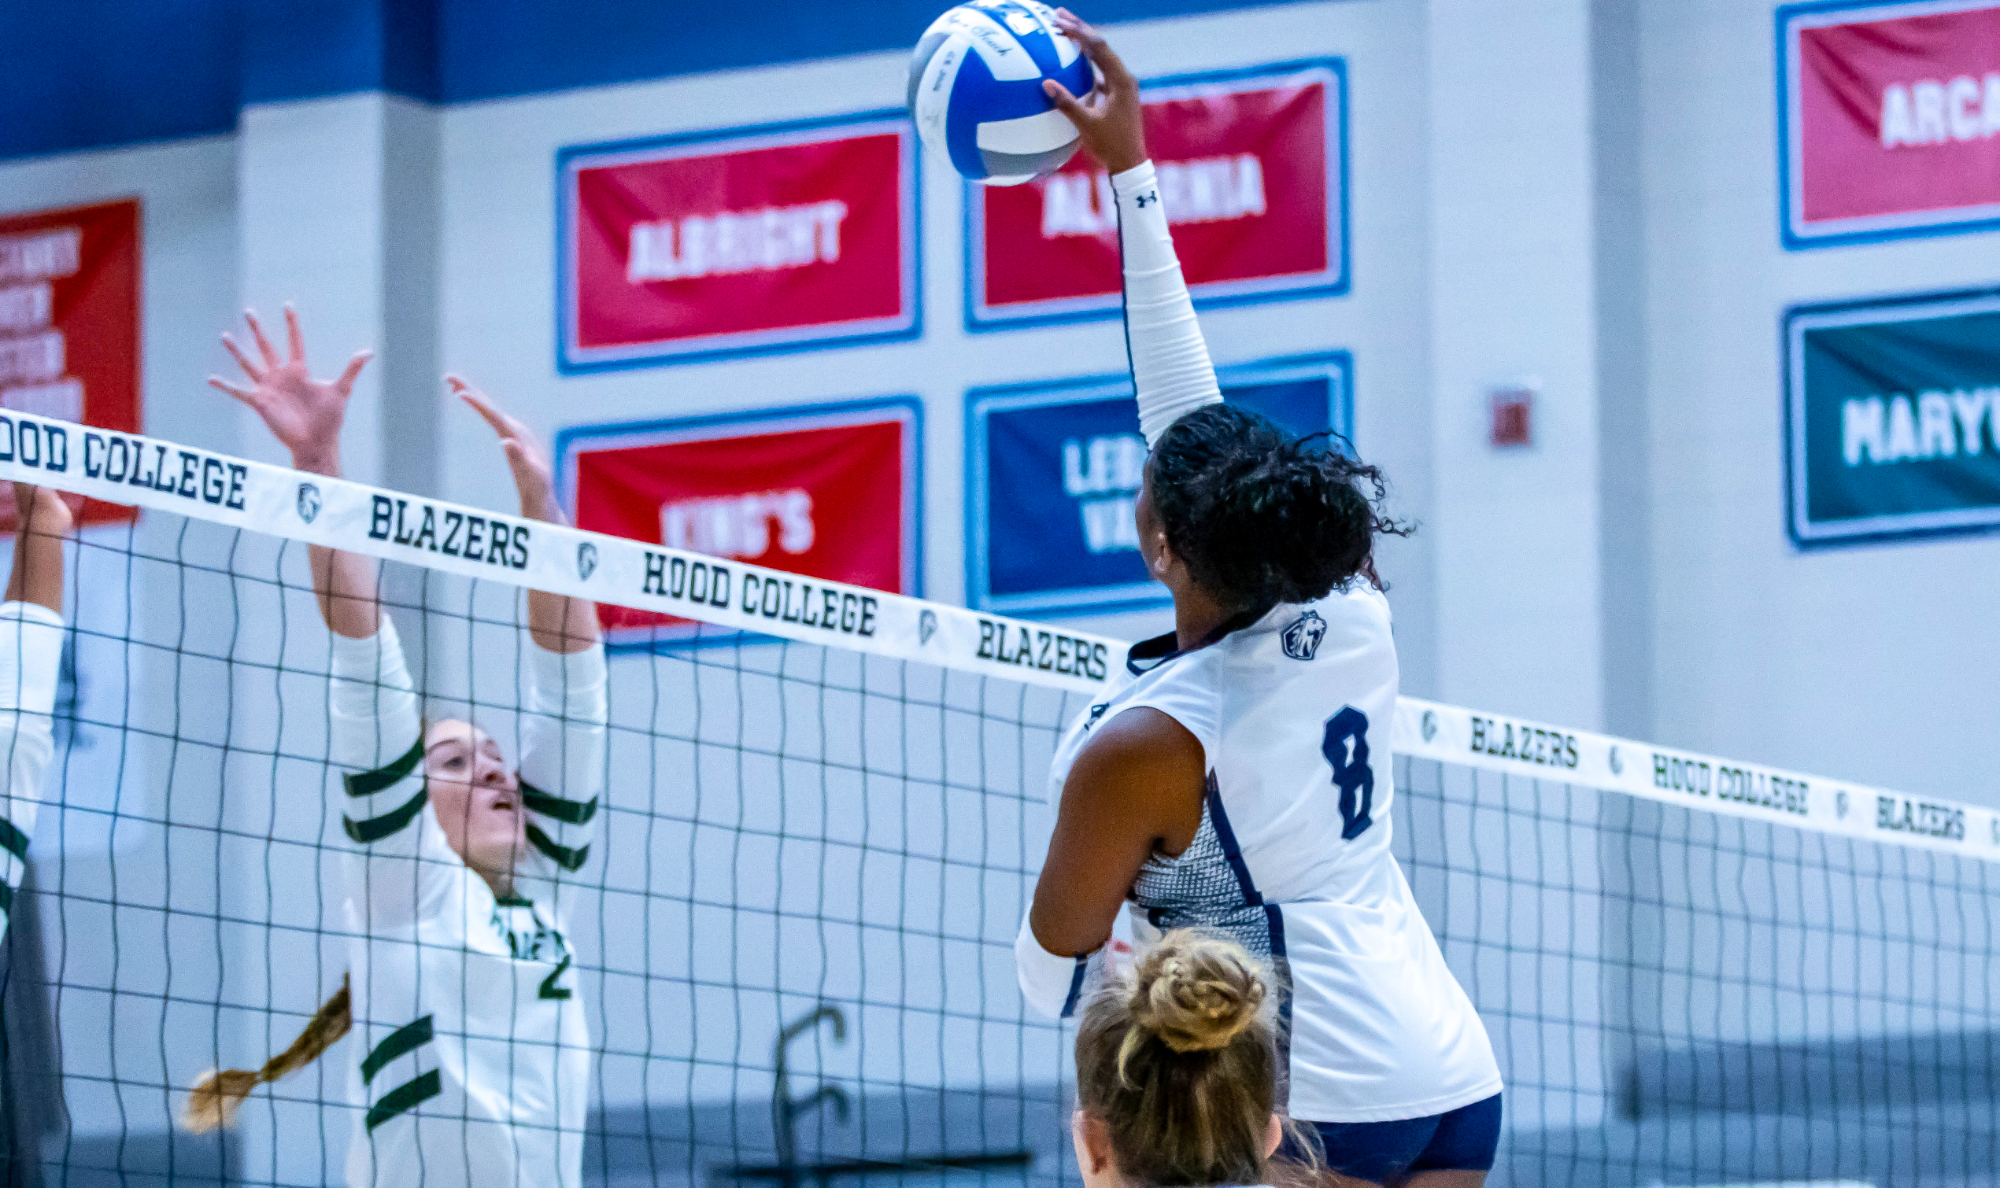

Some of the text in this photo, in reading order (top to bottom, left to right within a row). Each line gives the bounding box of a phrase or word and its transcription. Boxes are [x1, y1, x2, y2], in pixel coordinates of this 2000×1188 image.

[629, 199, 846, 283] ALBRIGHT
[84, 432, 248, 511] COLLEGE
[368, 494, 530, 569] BLAZERS
[643, 551, 878, 637] HOOD COLLEGE
[976, 619, 1107, 681] BLAZERS
[1321, 703, 1374, 841] 8
[1471, 716, 1578, 768] BLAZERS
[1652, 753, 1809, 815] HOOD COLLEGE
[1877, 795, 1965, 841] BLAZERS
